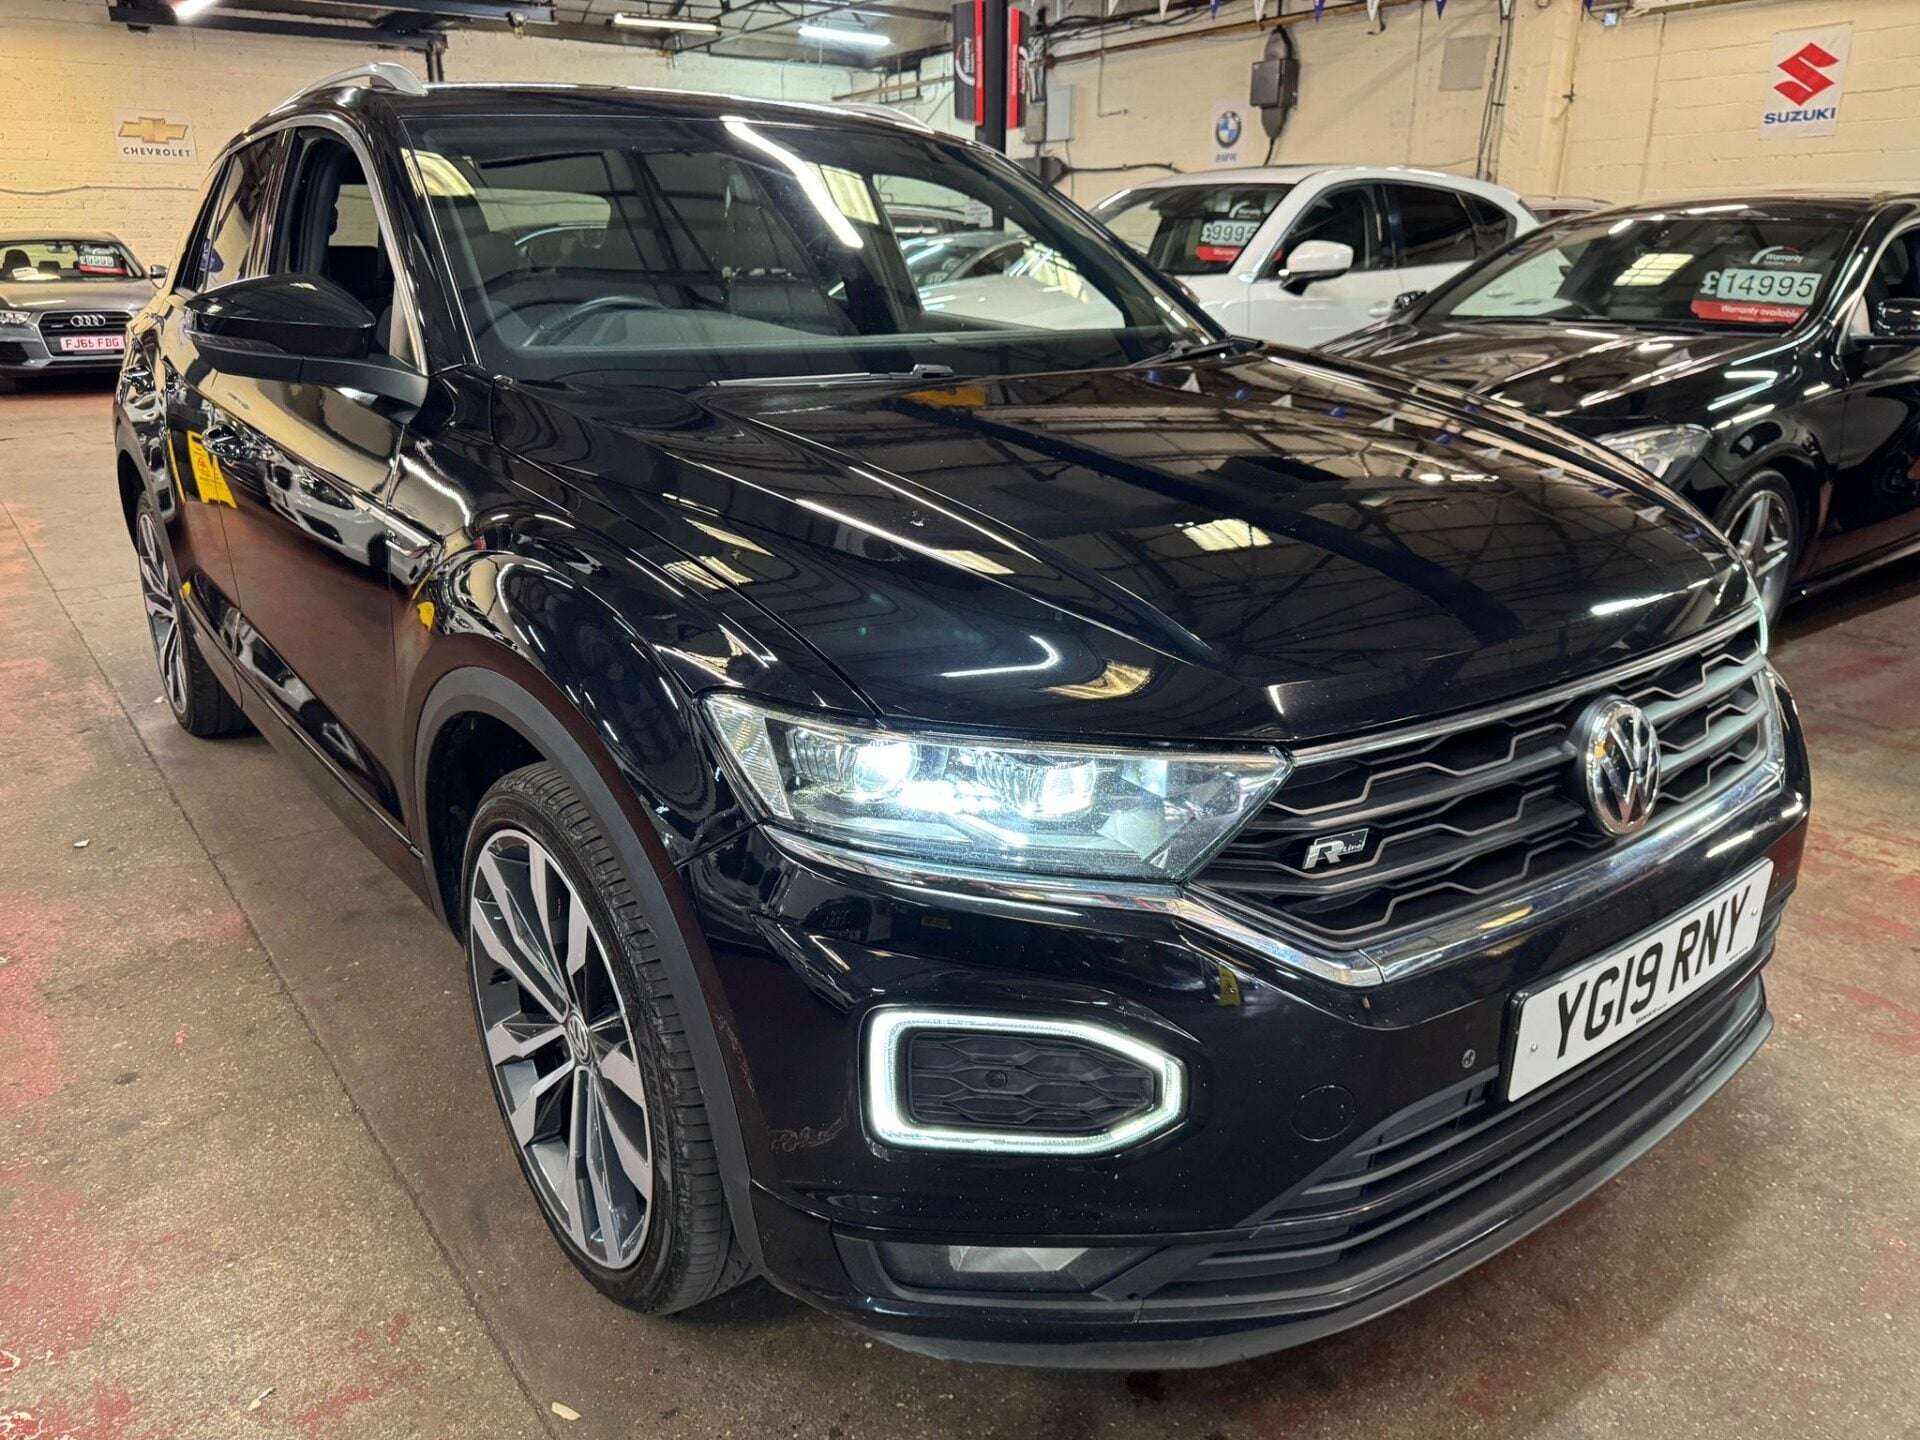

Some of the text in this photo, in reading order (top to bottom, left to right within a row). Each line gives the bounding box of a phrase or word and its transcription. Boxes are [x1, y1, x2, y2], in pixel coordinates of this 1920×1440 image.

[1763, 107, 1837, 124] SUZUKI
[123, 146, 191, 157] CHEVROLET
[1700, 270, 1816, 298] £14995
[1721, 304, 1800, 319] Warranty available
[1557, 885, 1751, 1060] YG19 RNY
